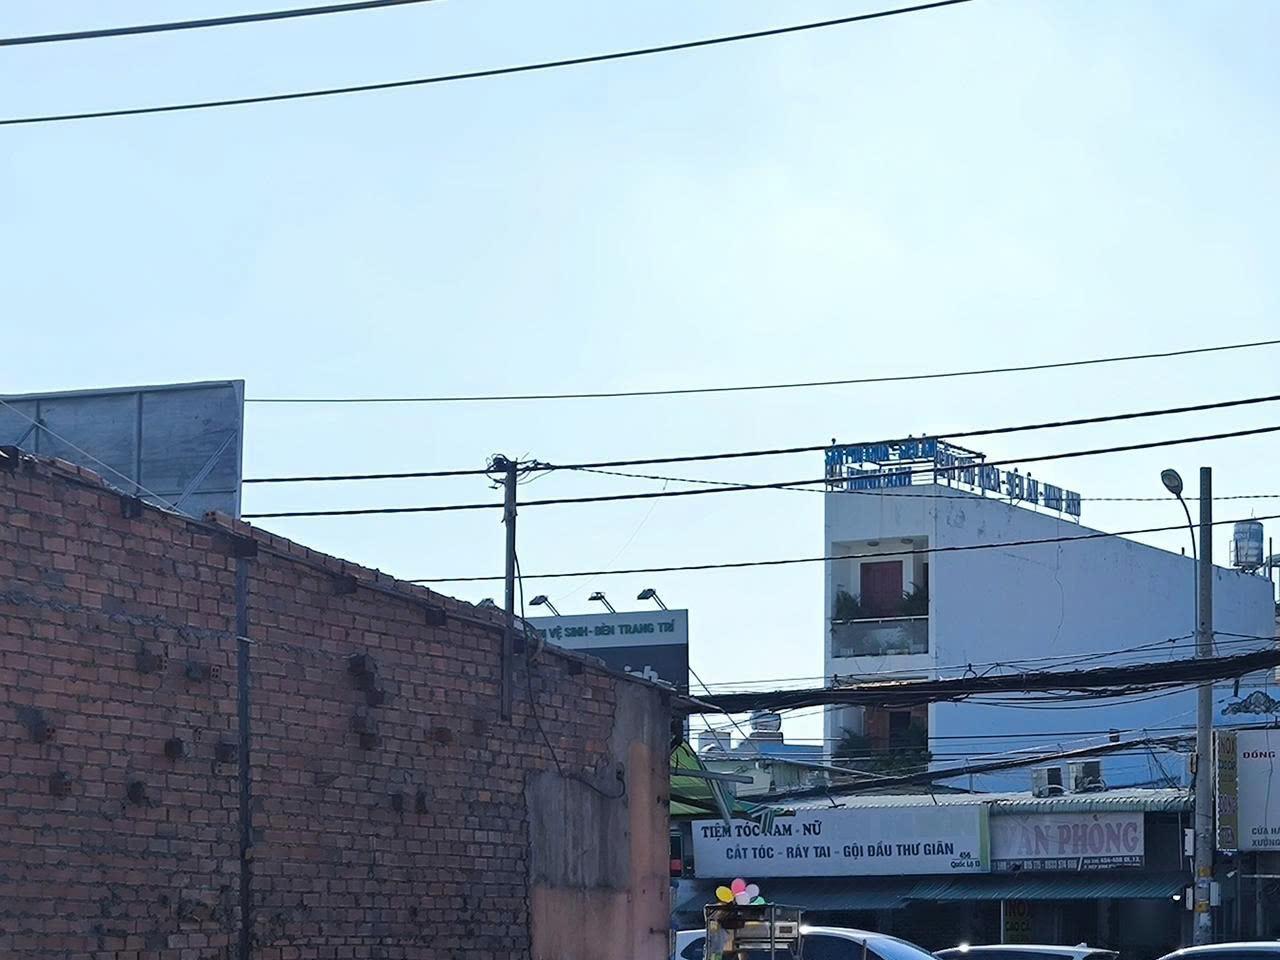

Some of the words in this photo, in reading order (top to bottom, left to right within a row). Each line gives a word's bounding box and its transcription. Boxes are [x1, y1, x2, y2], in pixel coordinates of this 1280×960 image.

[549, 625, 562, 640] VỆ
[564, 626, 589, 638] SINH
[594, 622, 615, 636] ĐÈN
[617, 622, 654, 635] TRANG
[657, 619, 675, 633] TRÍ
[701, 823, 731, 841] TIỆM
[735, 822, 760, 836] TÓC
[802, 820, 822, 836] NỮ
[1057, 815, 1139, 855] PHÒNG
[726, 844, 748, 859] CẮT
[752, 844, 774, 859] TÓC
[787, 844, 809, 858] RÁY
[813, 846, 831, 858] TAI
[843, 843, 864, 859] GỘI
[867, 841, 892, 857] ĐẦU
[896, 843, 921, 856] THƯ
[923, 841, 954, 855] GIÃN
